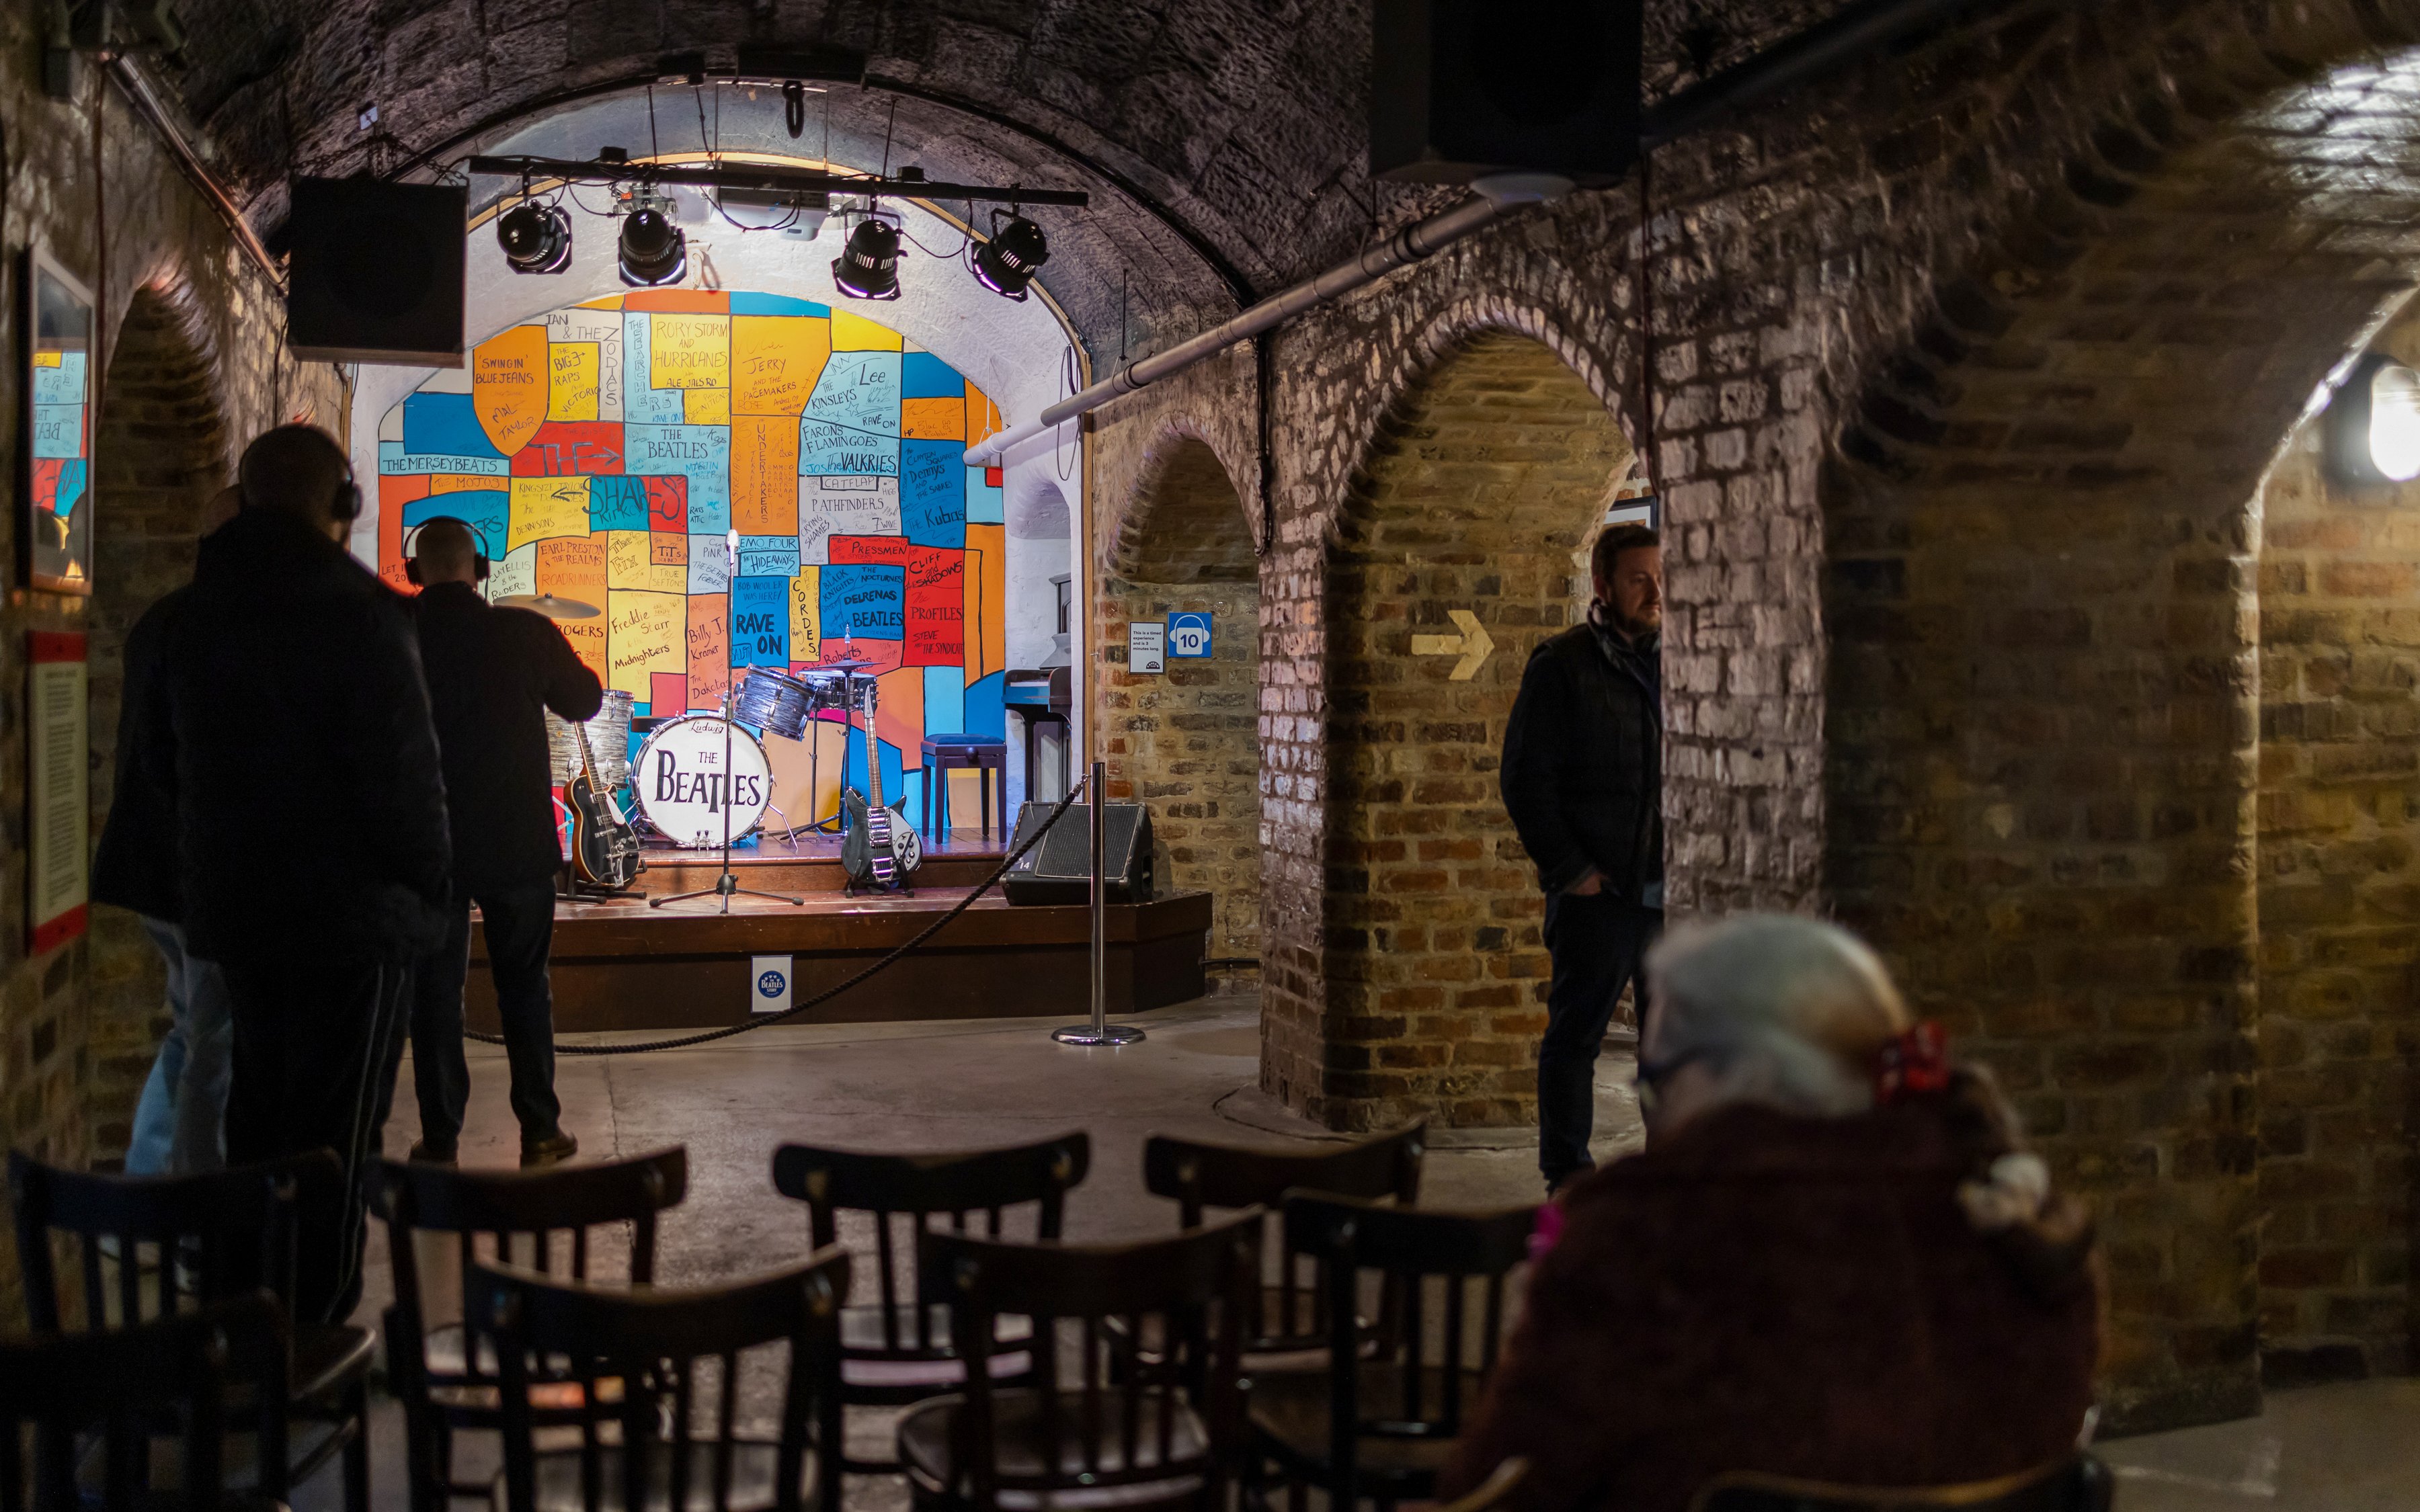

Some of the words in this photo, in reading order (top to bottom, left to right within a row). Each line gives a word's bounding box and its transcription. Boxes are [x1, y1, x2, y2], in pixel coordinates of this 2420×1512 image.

[546, 314, 568, 325] IAN
[629, 320, 644, 330] THE
[563, 327, 572, 339] &
[577, 327, 601, 339] THE
[657, 321, 692, 338] RORY
[695, 323, 727, 337] STORM
[679, 339, 694, 348] AND
[556, 347, 569, 355] THE
[554, 356, 571, 371] BIG
[654, 350, 727, 368] HURRICANES
[742, 357, 786, 374] JERRY
[555, 372, 580, 386] RAPS
[769, 376, 782, 384] THE
[859, 364, 885, 386] Lee
[743, 382, 797, 400] PACEMAKERS
[820, 380, 834, 392] THE
[811, 388, 857, 410] KINSLEYS
[862, 414, 882, 426] RAVE
[883, 420, 895, 428] ON
[499, 417, 538, 440] TAYLOR
[661, 429, 682, 439] THE
[802, 425, 844, 441] FARONS
[647, 442, 708, 458] BEATLES
[807, 436, 877, 454] FLAMINGOES
[383, 460, 406, 471] THE
[408, 457, 497, 472] MERSEYBEATS
[527, 442, 596, 476] THE
[841, 452, 897, 473] VALKRIES
[456, 478, 499, 488] MOJOS
[520, 483, 552, 493] KINGSIZE
[559, 482, 584, 491] TAYLOR
[825, 476, 874, 489] CATFLAP
[812, 498, 884, 511] PATHFINDERS
[516, 517, 555, 535] DENNISONS
[801, 514, 822, 538] CRYING
[881, 520, 897, 529] WAVE
[805, 520, 830, 549] SHAMES
[540, 542, 565, 555] EARL
[567, 542, 606, 555] PRESTON
[740, 538, 764, 547] EMO
[769, 538, 797, 549] FOUR
[852, 541, 908, 555] PRESSMEN
[552, 554, 564, 562] THE
[567, 554, 602, 566] REALMS
[751, 554, 795, 573] HIDEAWAYS
[910, 551, 942, 574] CLIFF
[382, 564, 396, 575] LET
[660, 569, 679, 577] TRUE
[916, 560, 963, 587] SHADOWS
[542, 573, 606, 587] ROADRUNNERS
[738, 581, 752, 590] BOB
[823, 569, 848, 590] BLACK
[861, 575, 903, 583] NOCTURNES
[823, 577, 854, 602] KNIGHTS
[743, 593, 757, 601] WAS
[844, 590, 897, 605] DELRENAS
[852, 611, 903, 627] BEATLES
[910, 606, 962, 620] PROFILES
[612, 609, 650, 634] Freddie
[641, 620, 670, 634] Starr
[736, 613, 774, 634] RAVE
[688, 624, 711, 648] Billy
[711, 617, 725, 634] J.
[913, 630, 939, 642] STEVE
[757, 634, 782, 656] ON
[1180, 634, 1199, 648] 10
[691, 645, 719, 661] Kramer
[823, 646, 862, 665] Roberts
[922, 643, 935, 655] THE
[614, 644, 670, 670] Midnighters
[690, 675, 702, 685] The
[689, 721, 724, 734] Ludwig
[698, 751, 718, 763] THE
[654, 749, 761, 813] BEATLES
[761, 979, 783, 988] BEATLES
